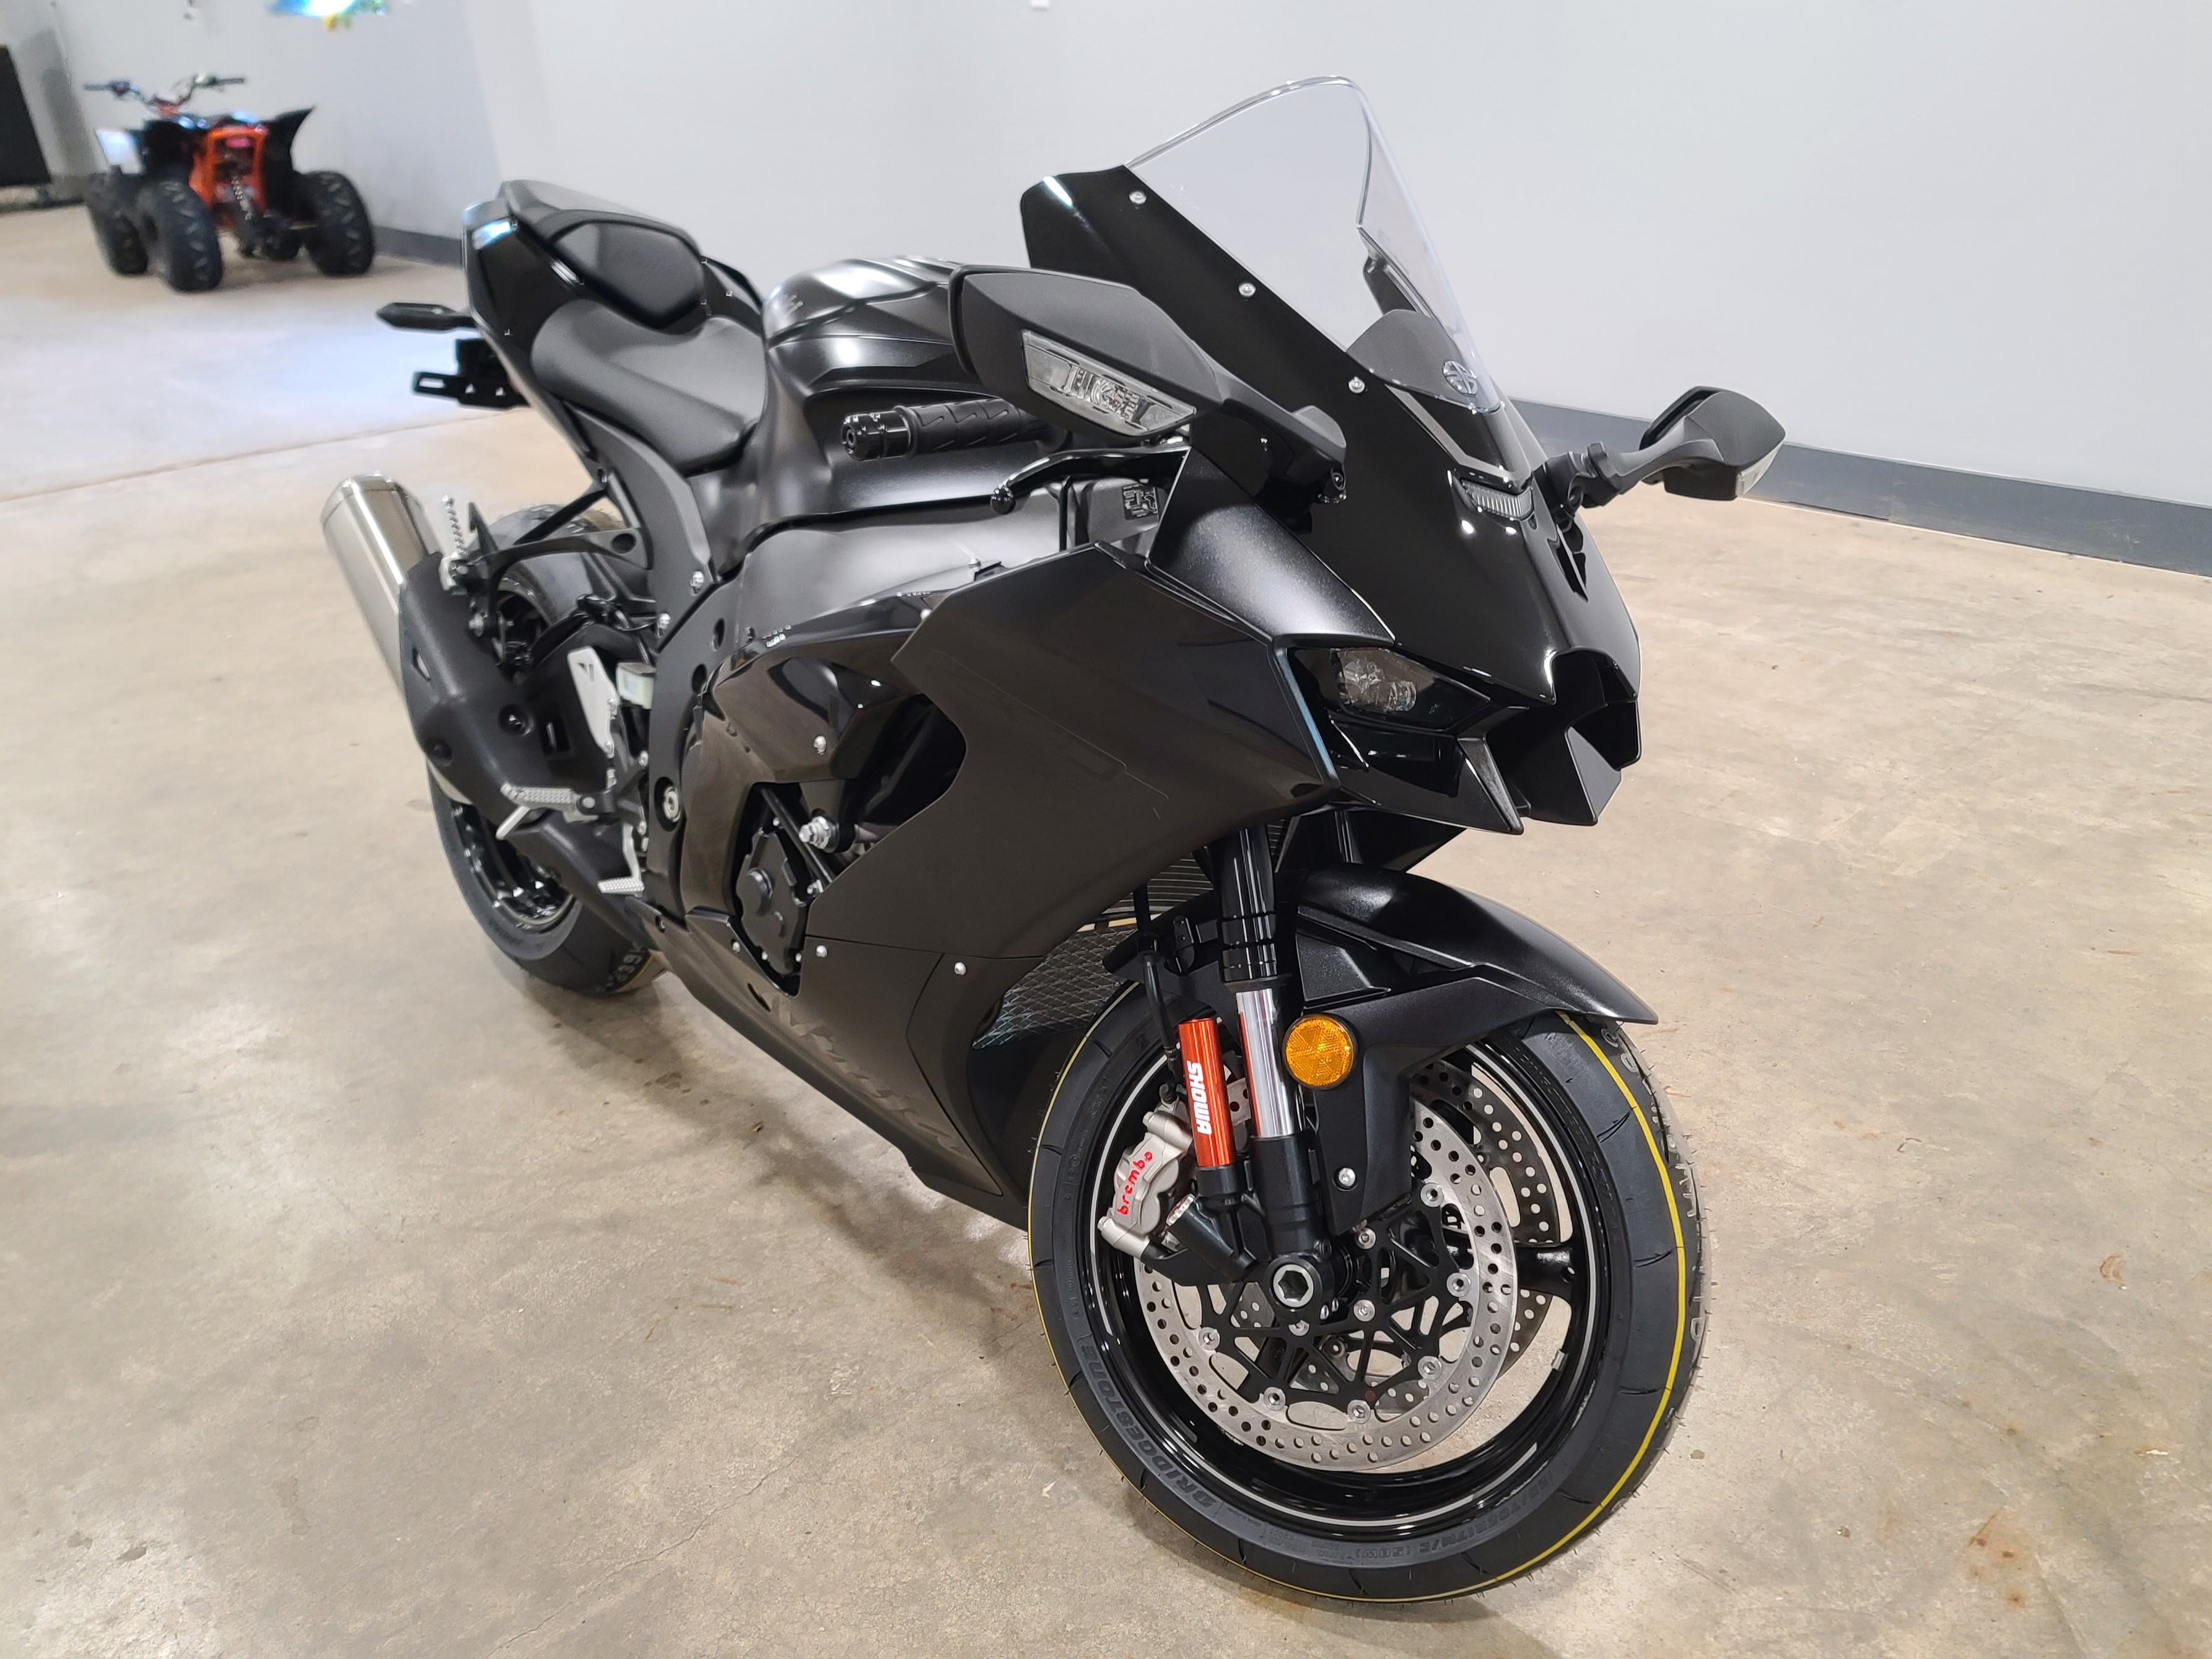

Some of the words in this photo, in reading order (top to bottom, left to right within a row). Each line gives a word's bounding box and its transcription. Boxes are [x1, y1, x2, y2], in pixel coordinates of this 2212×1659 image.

[1186, 1061, 1212, 1135] SHOWA
[1117, 1151, 1153, 1216] brembo
[1080, 1344, 1218, 1508] BRIDGESTONE
